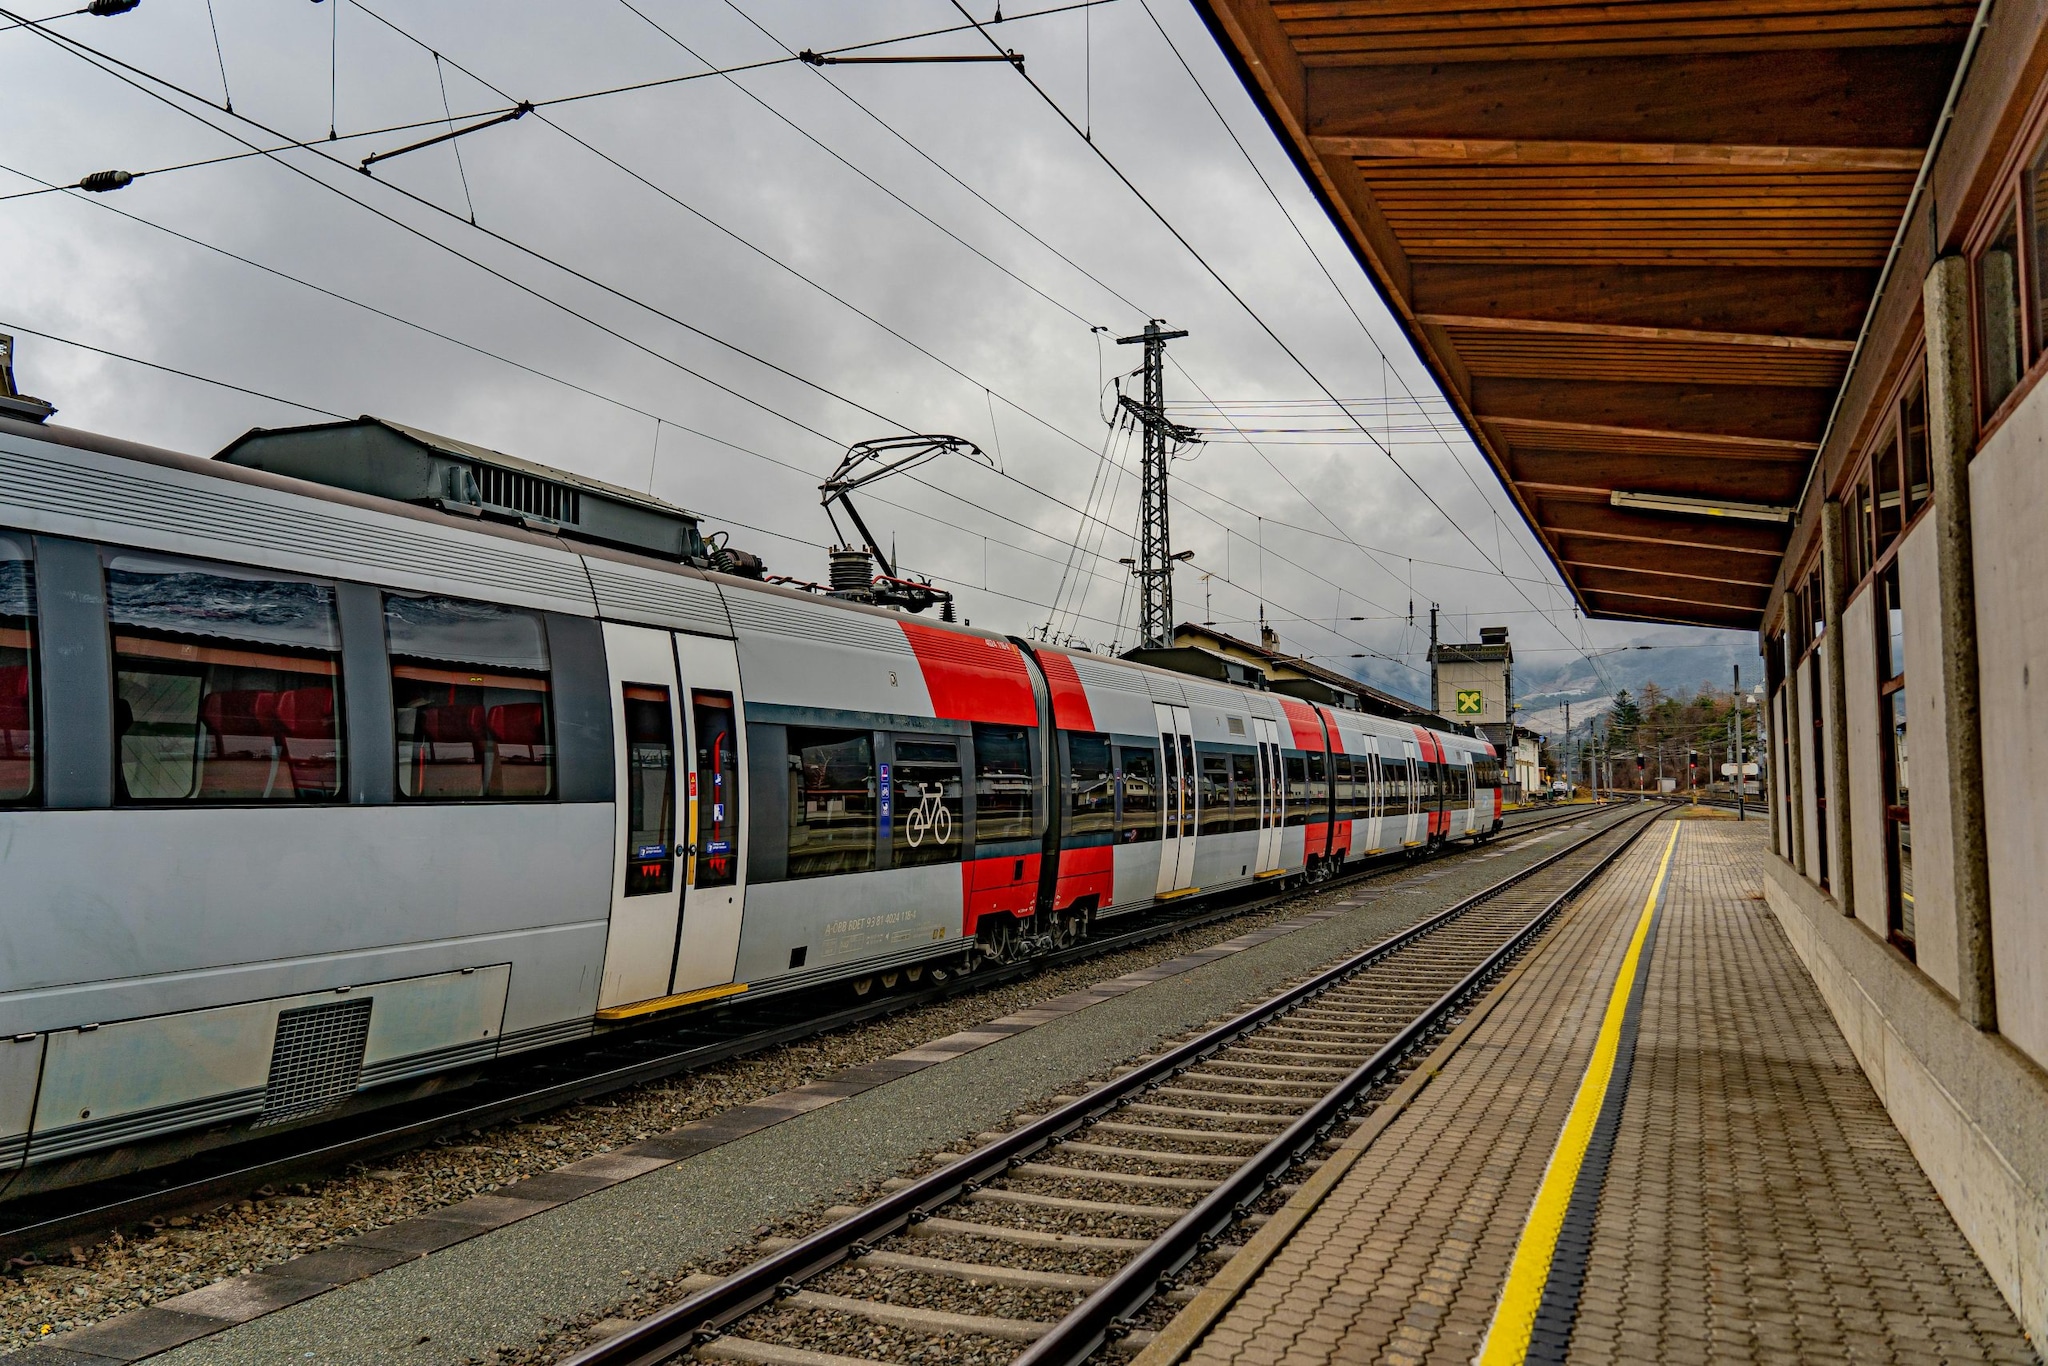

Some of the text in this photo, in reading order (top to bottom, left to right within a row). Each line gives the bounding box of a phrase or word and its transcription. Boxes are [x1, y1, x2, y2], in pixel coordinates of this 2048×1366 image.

[866, 916, 875, 928] 93
[876, 915, 884, 926] 81
[885, 912, 900, 925] 4024
